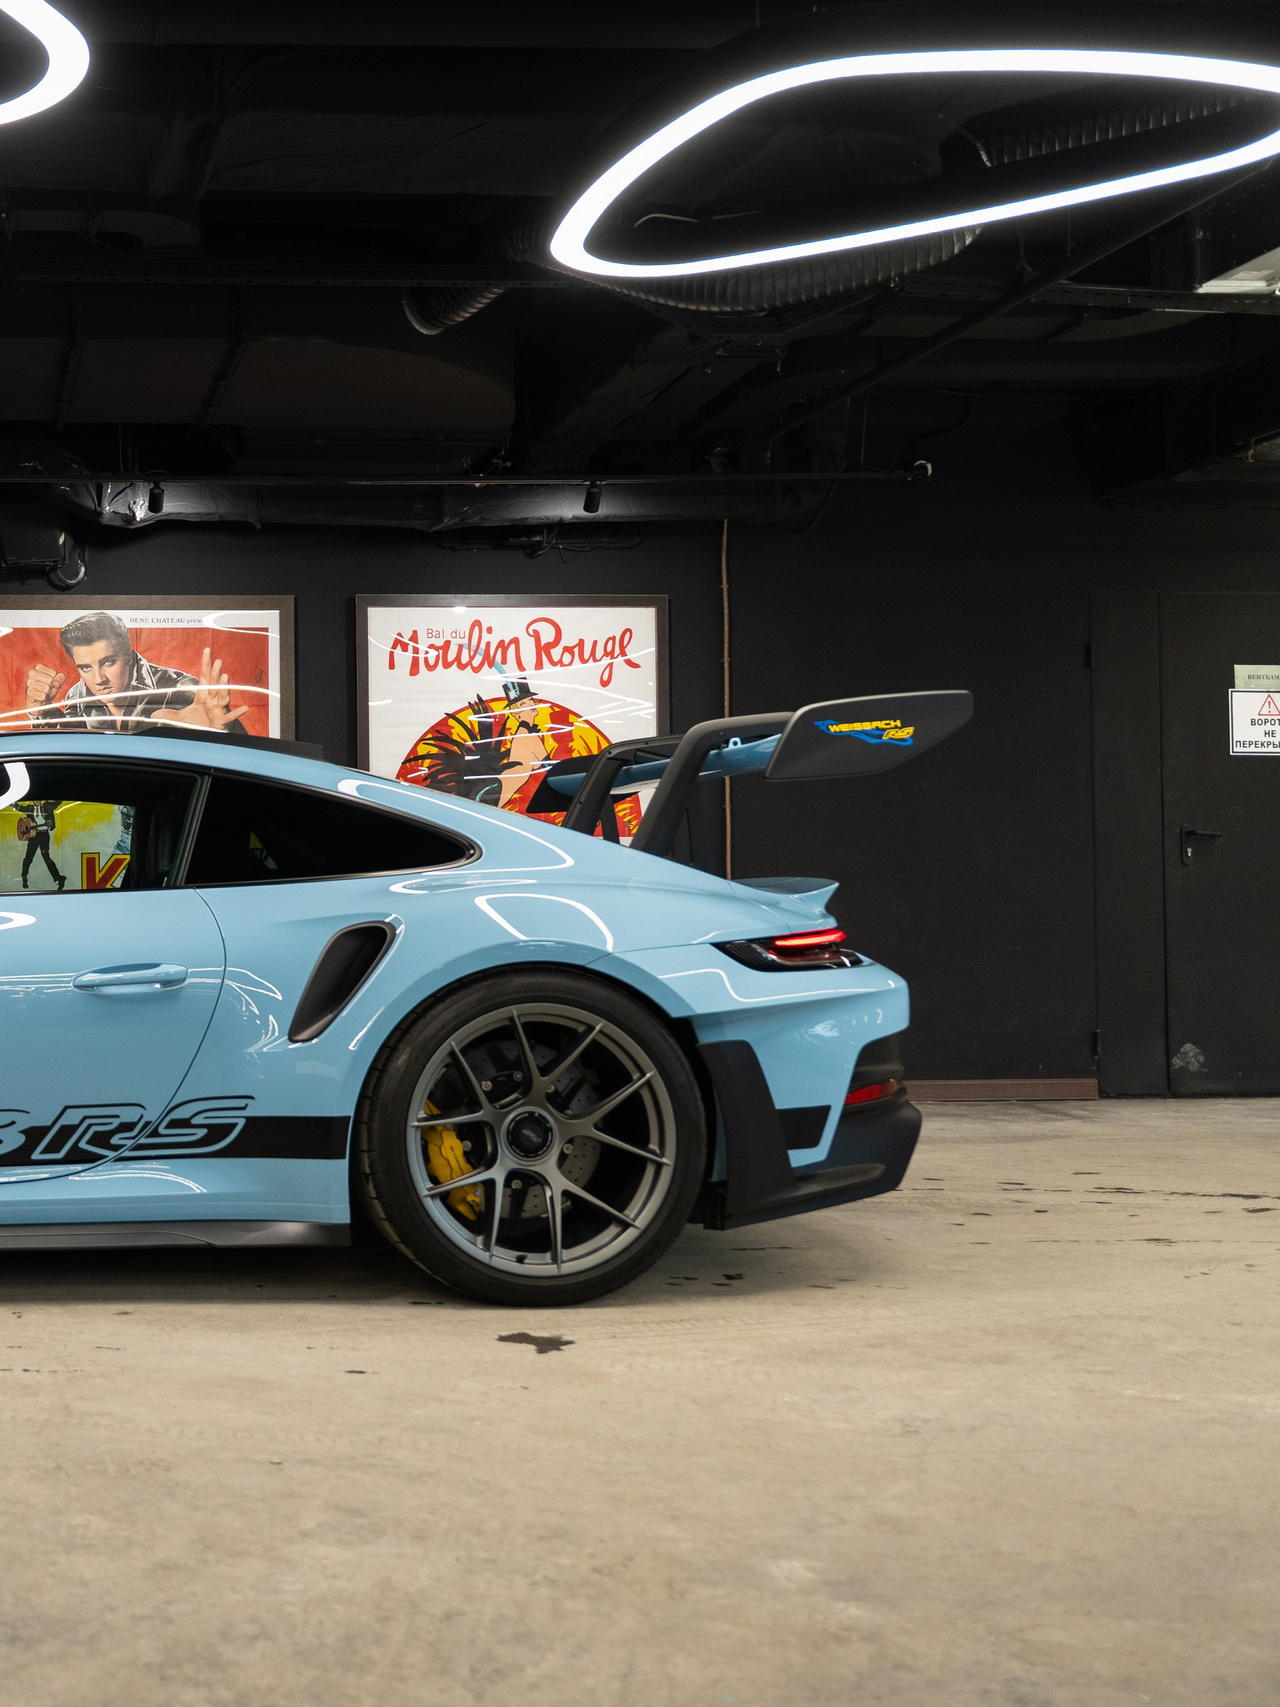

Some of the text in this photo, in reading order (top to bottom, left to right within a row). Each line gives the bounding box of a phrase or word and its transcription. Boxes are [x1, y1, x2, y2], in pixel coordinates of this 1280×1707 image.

[129, 616, 150, 624] RENÉ
[426, 628, 466, 639] Bal du
[388, 617, 642, 688] Moulin Rouge
[828, 719, 901, 733] WEISSACH
[882, 726, 915, 740] RS
[1264, 729, 1277, 738] НЕ
